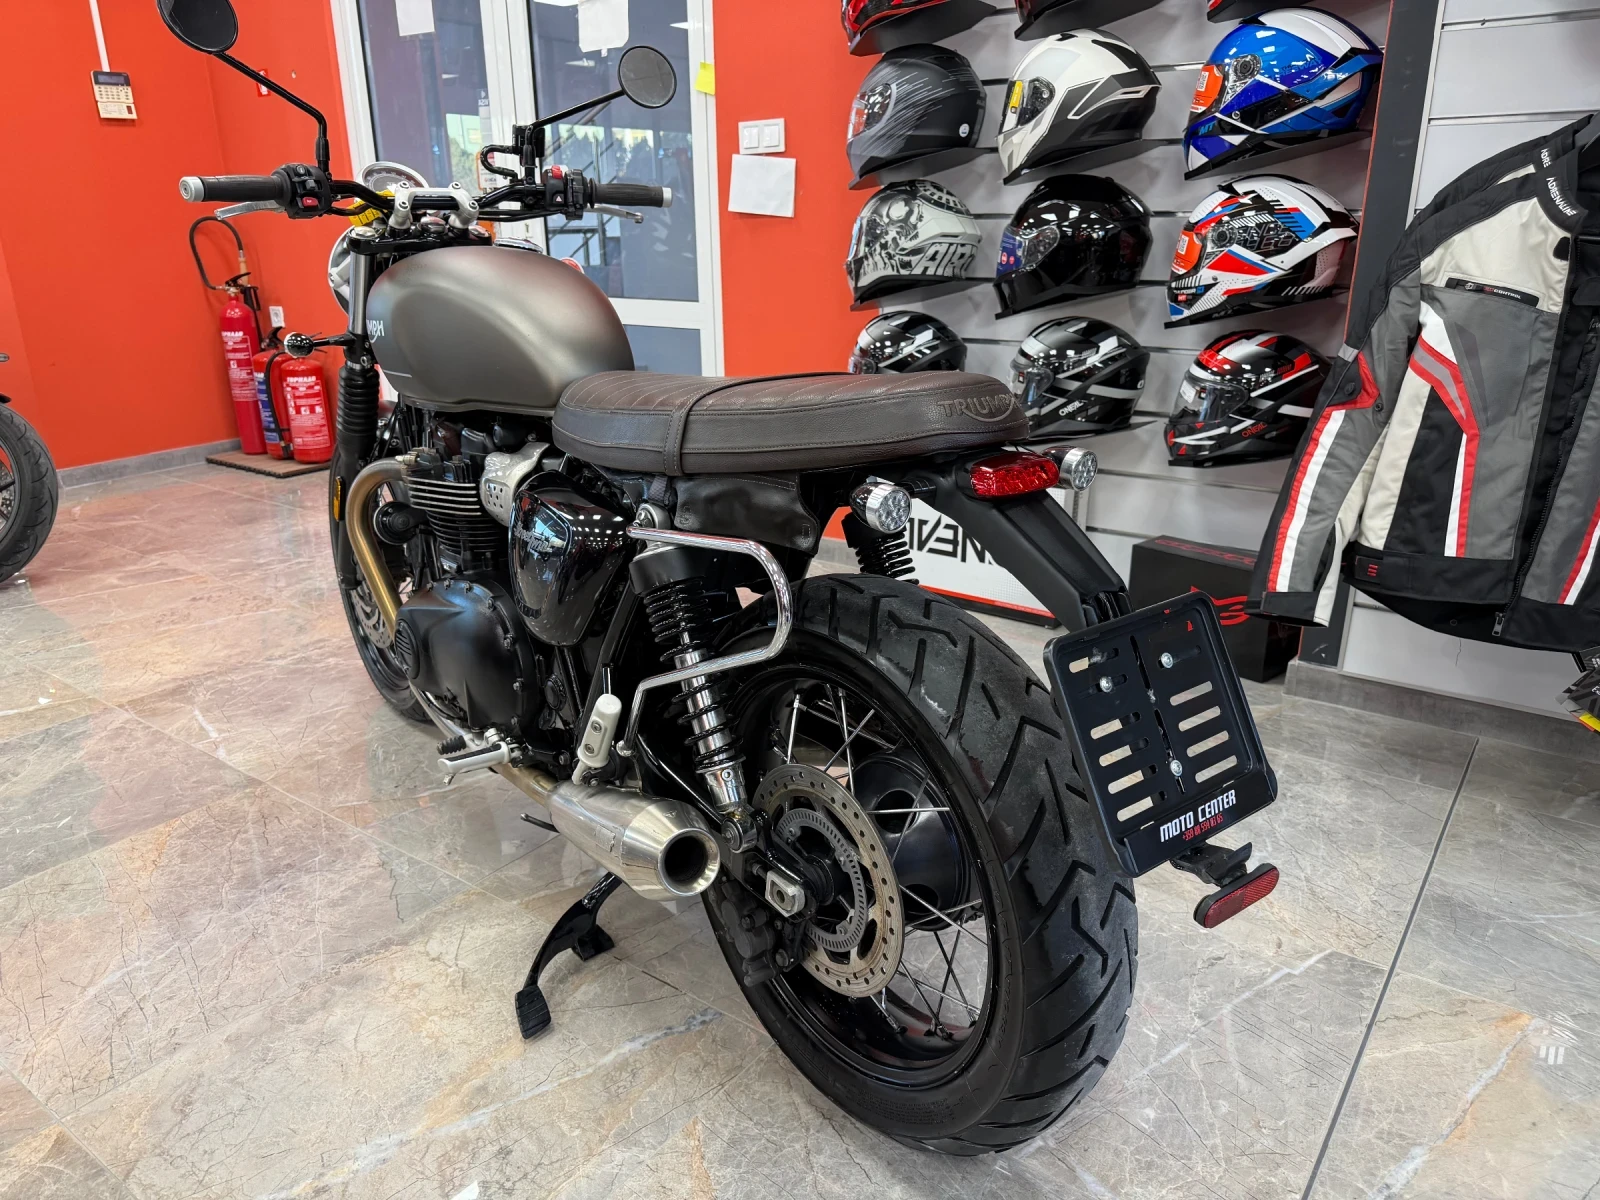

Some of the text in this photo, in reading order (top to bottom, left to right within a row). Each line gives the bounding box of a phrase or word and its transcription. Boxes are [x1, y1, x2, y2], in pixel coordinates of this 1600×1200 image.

[1199, 121, 1216, 136] MT
[907, 514, 993, 566] NEAL
[1160, 789, 1236, 842] MOTO CENTER
